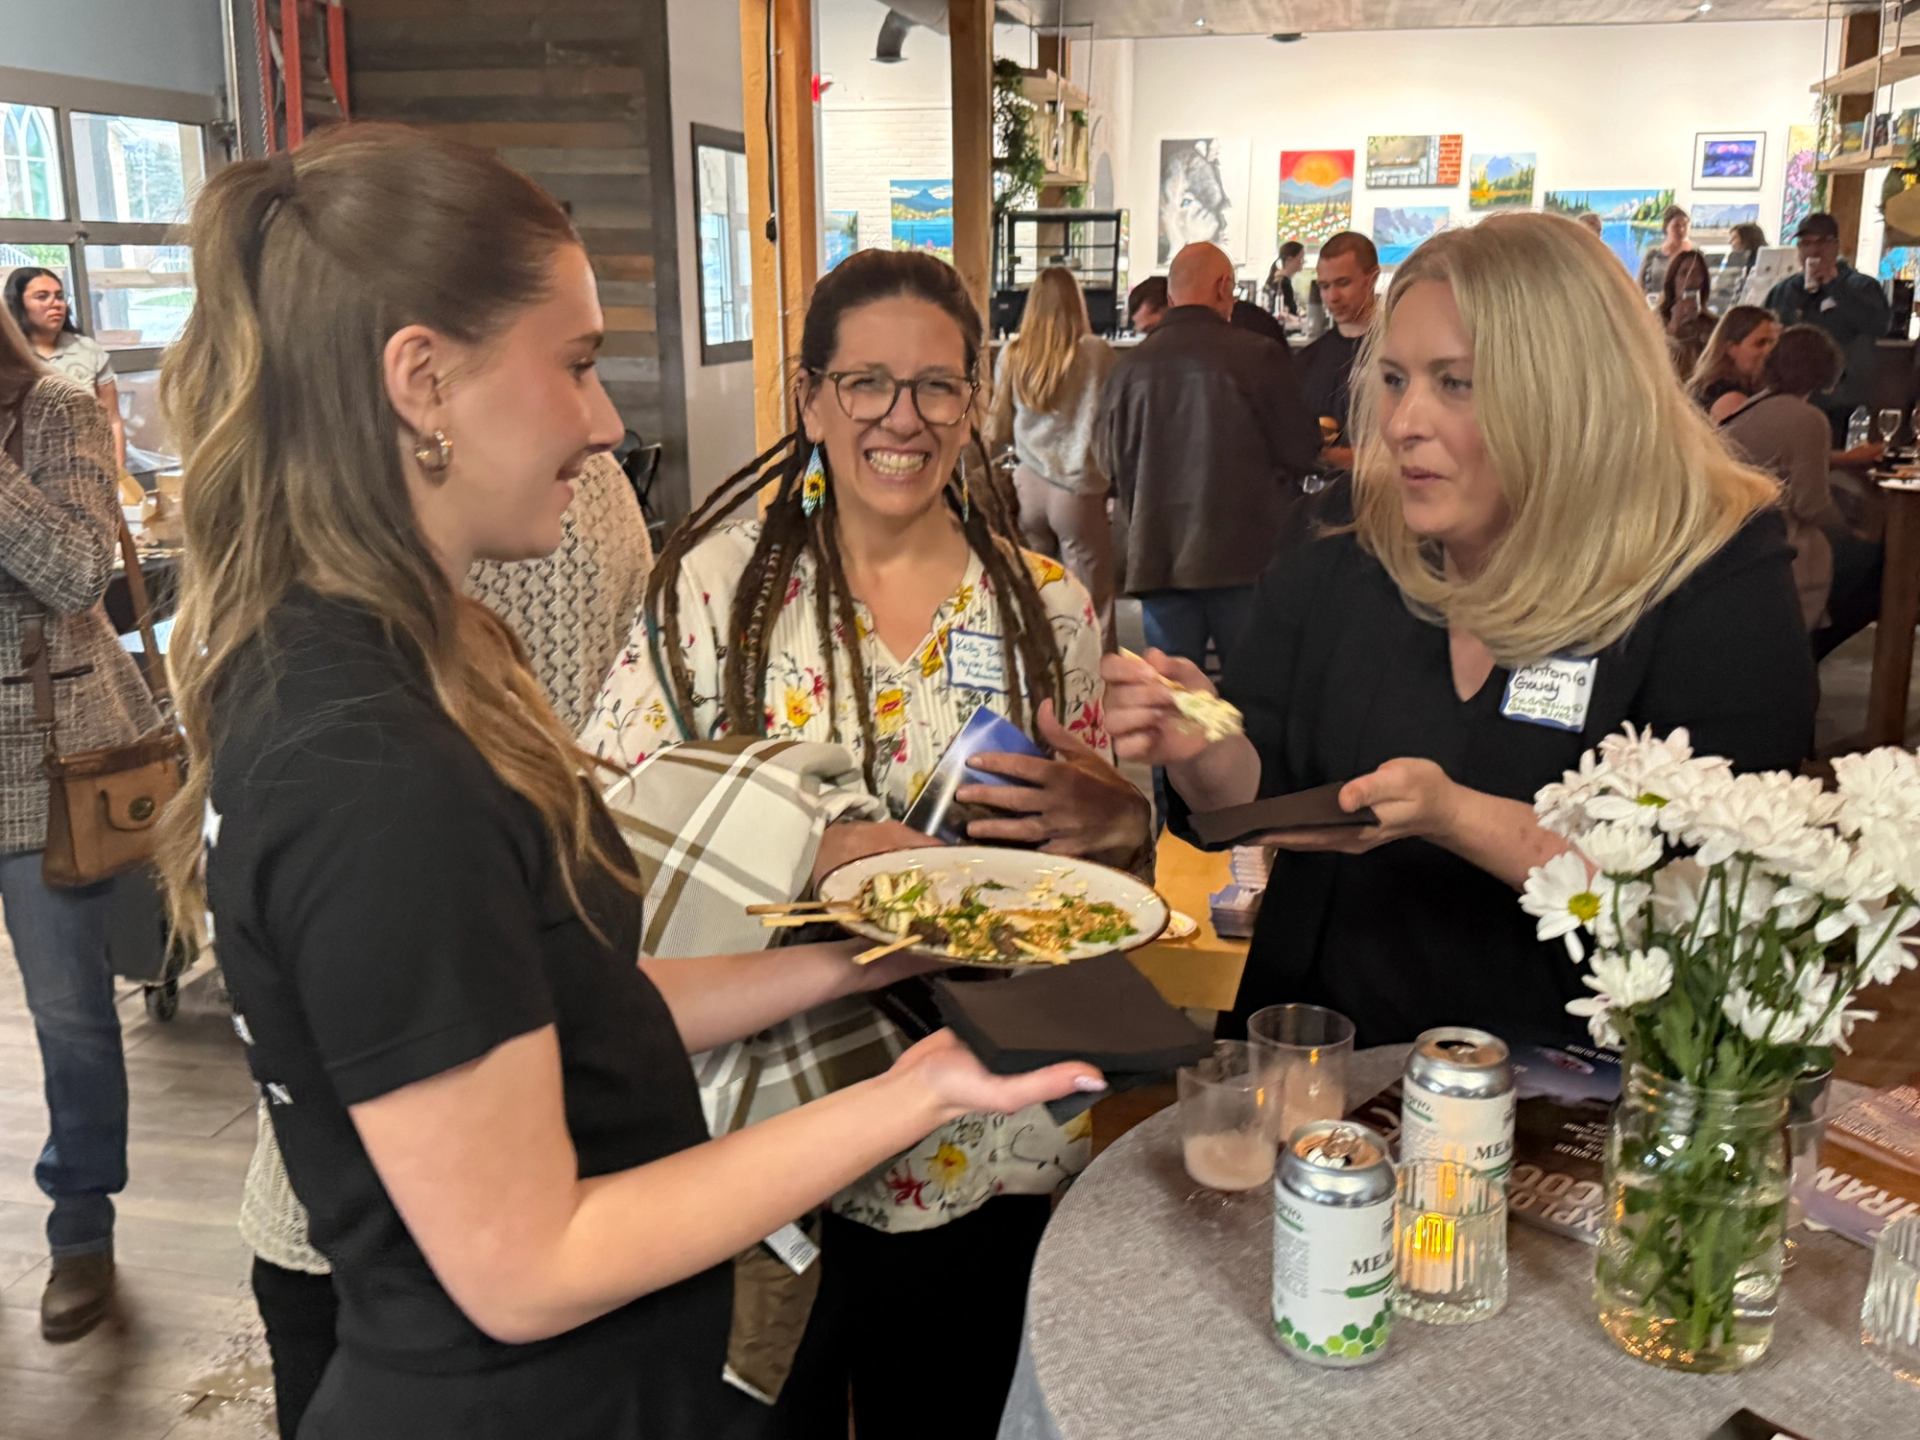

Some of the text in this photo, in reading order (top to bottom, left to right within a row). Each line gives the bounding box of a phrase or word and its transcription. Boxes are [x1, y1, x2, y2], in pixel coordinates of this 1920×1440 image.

[1473, 1139, 1513, 1161] MEA
[1511, 1164, 1604, 1205] COC
[1815, 1166, 1920, 1227] RAN
[1510, 1190, 1607, 1232] XPLO
[1347, 1249, 1394, 1277] MEA
